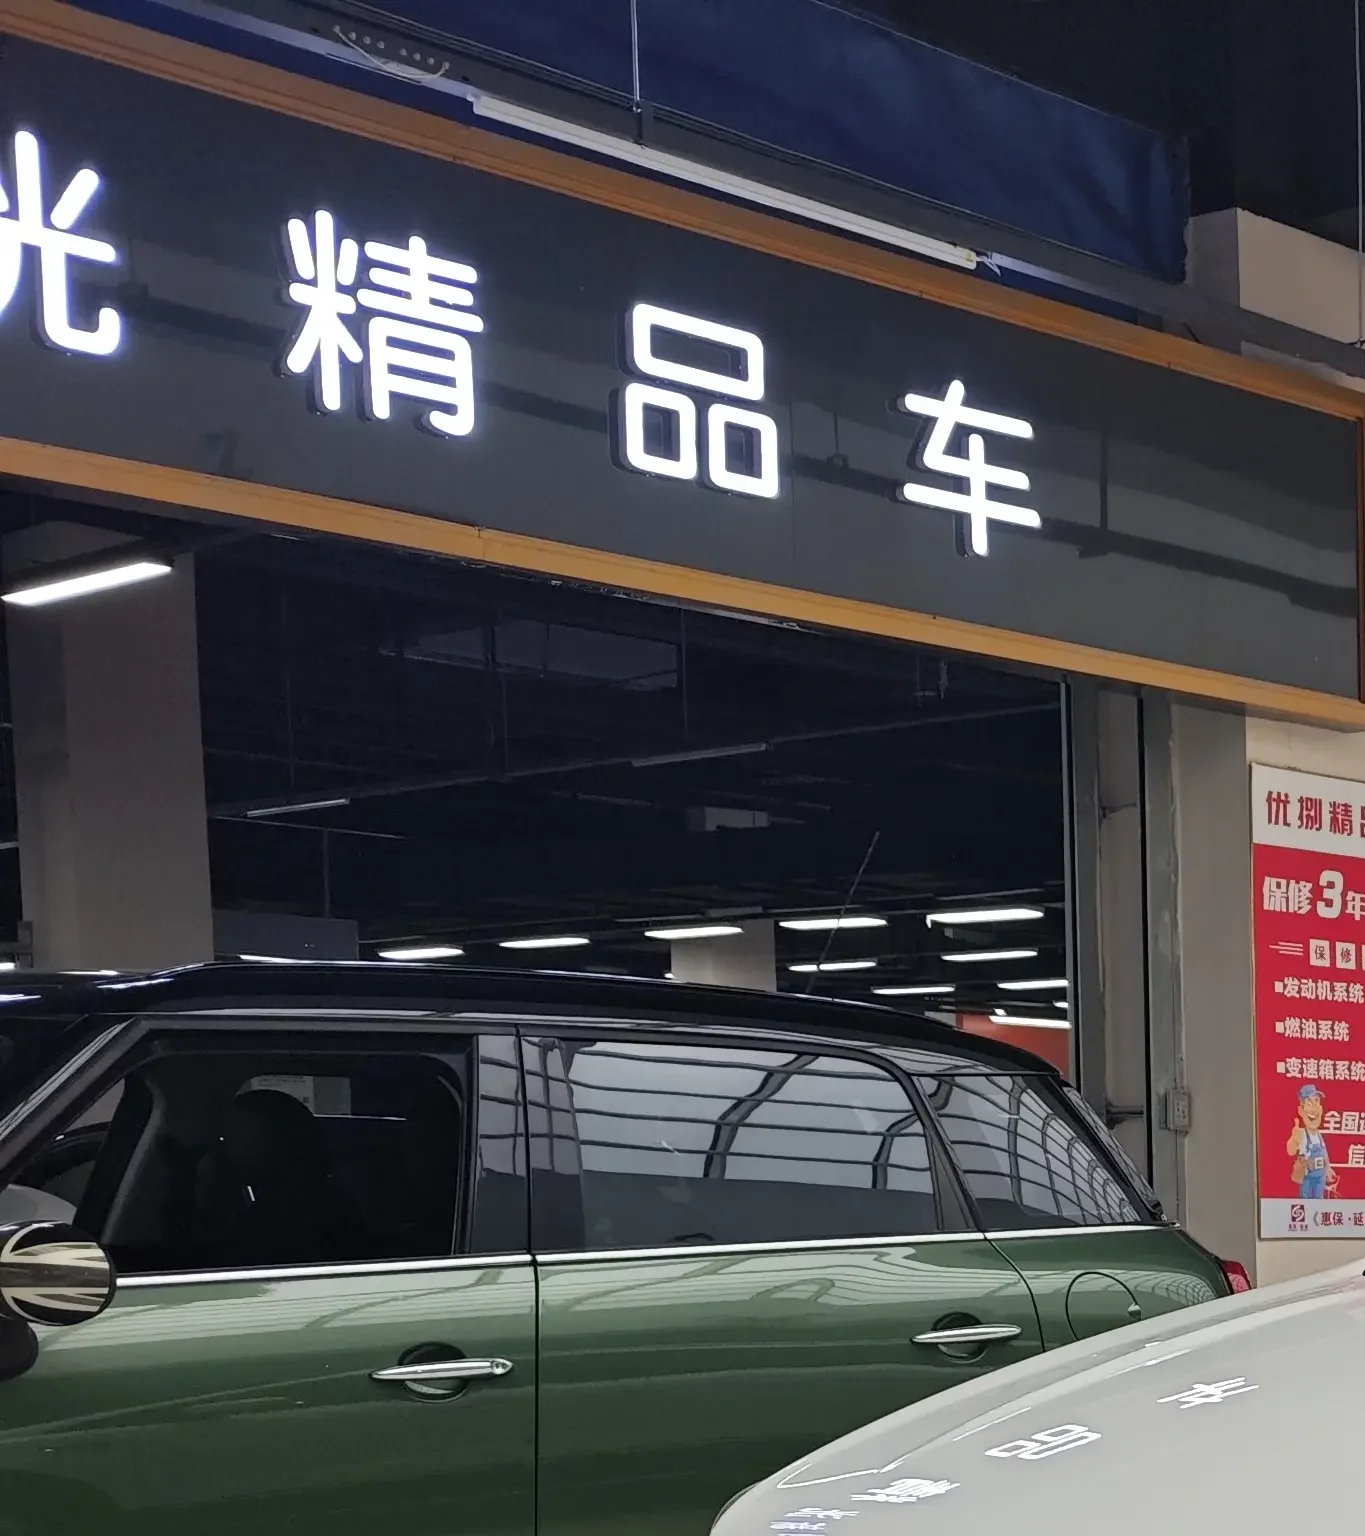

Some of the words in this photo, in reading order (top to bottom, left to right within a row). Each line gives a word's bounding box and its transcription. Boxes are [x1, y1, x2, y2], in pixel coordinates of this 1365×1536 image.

[1283, 976, 1365, 1004] 发动机系统
[1284, 1016, 1350, 1042] 燃油系统
